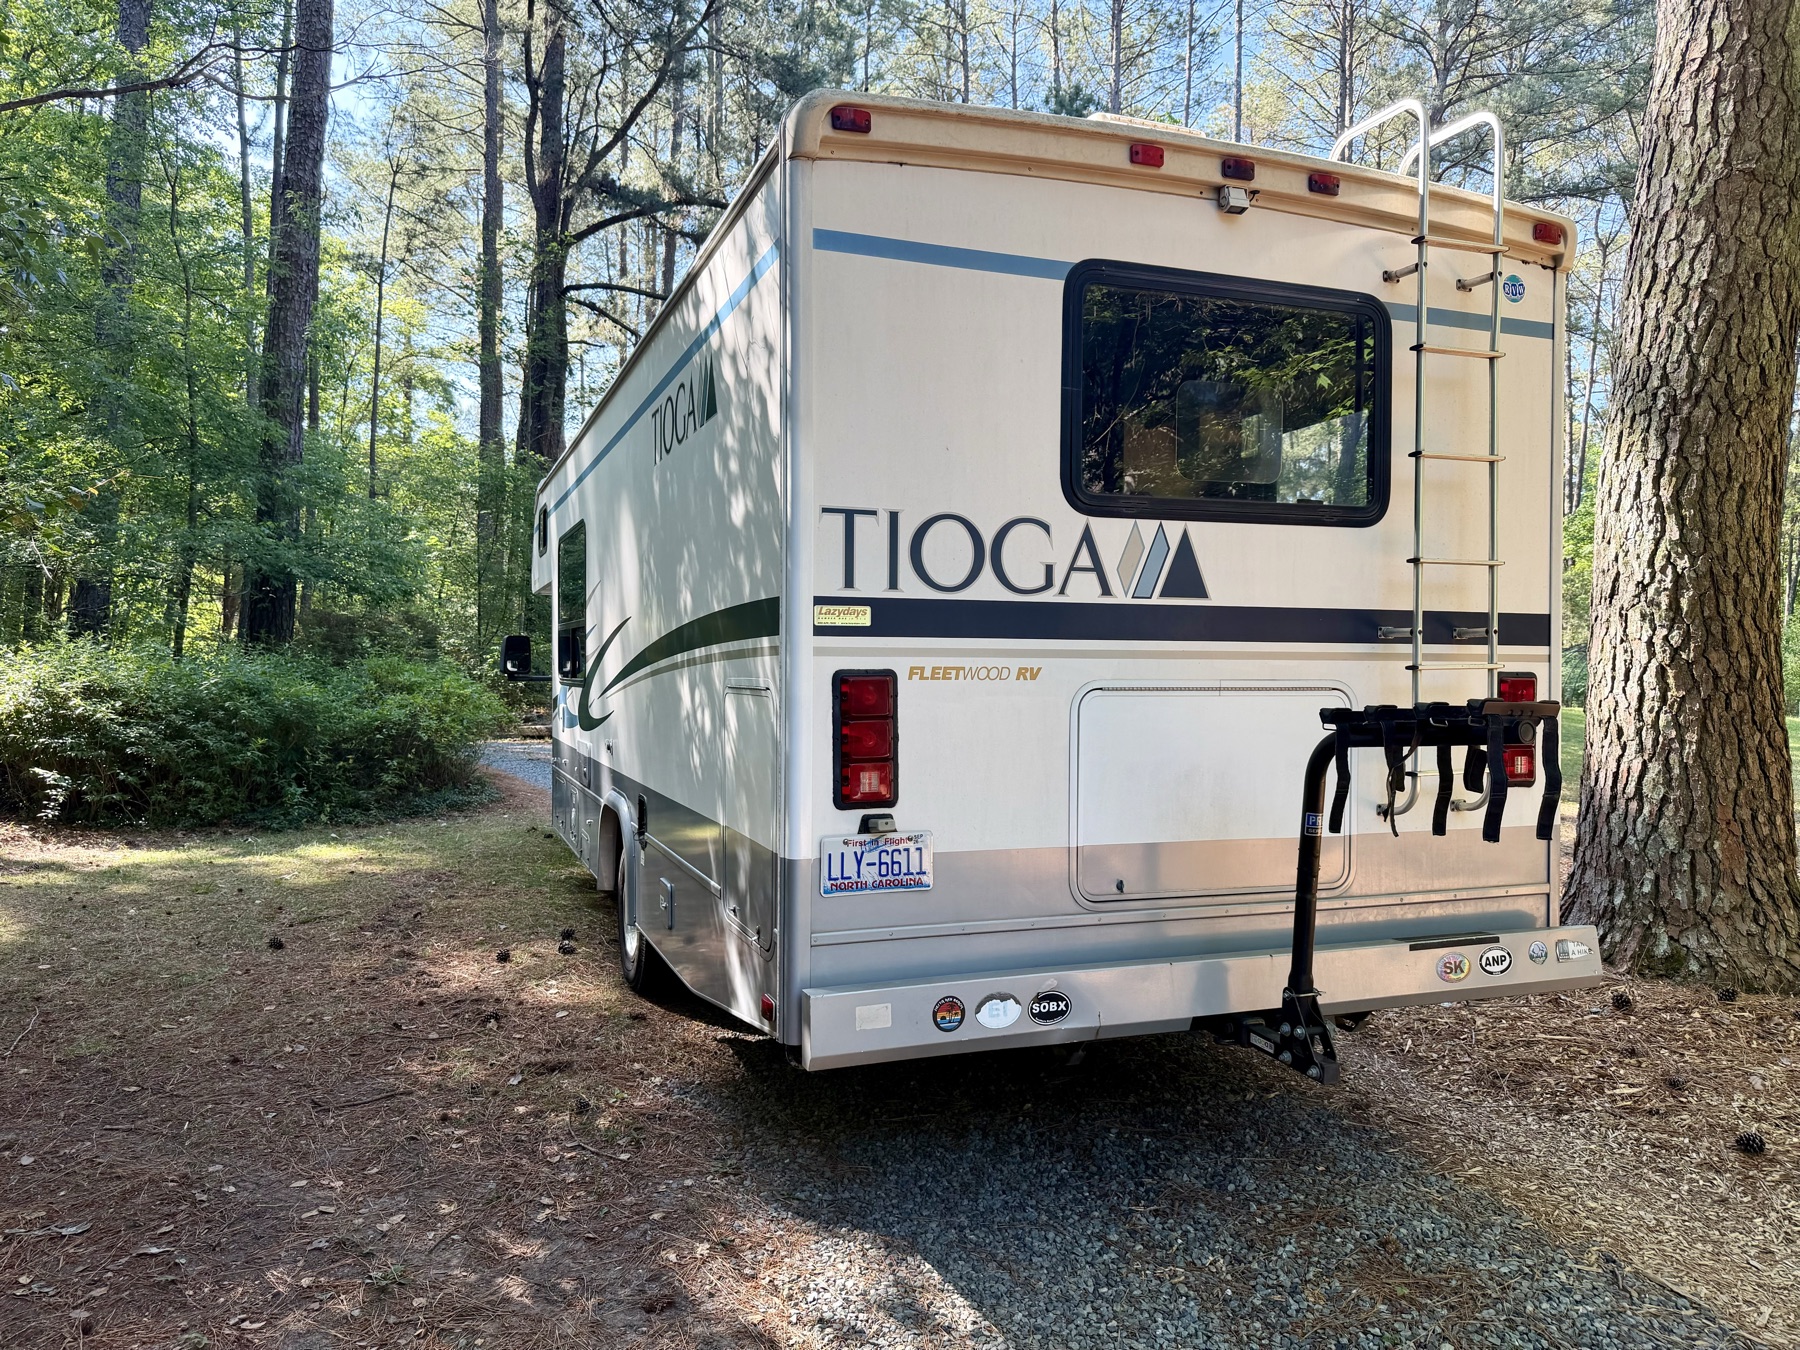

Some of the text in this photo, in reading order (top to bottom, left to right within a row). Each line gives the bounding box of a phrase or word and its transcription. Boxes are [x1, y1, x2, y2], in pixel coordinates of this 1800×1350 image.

[651, 369, 698, 467] TIOGA
[818, 504, 1117, 600] TIOGA
[818, 606, 868, 618] Lazydays
[908, 666, 1042, 681] FLEETWOOD RV
[1309, 815, 1323, 826] PR
[847, 839, 867, 847] First
[884, 836, 909, 846] Flight
[827, 847, 927, 881] LLY-6611
[830, 877, 924, 891] NORTH CAROLINA
[1443, 960, 1465, 974] SK
[1484, 954, 1507, 968] ANP
[1032, 1001, 1067, 1014] SOBX
